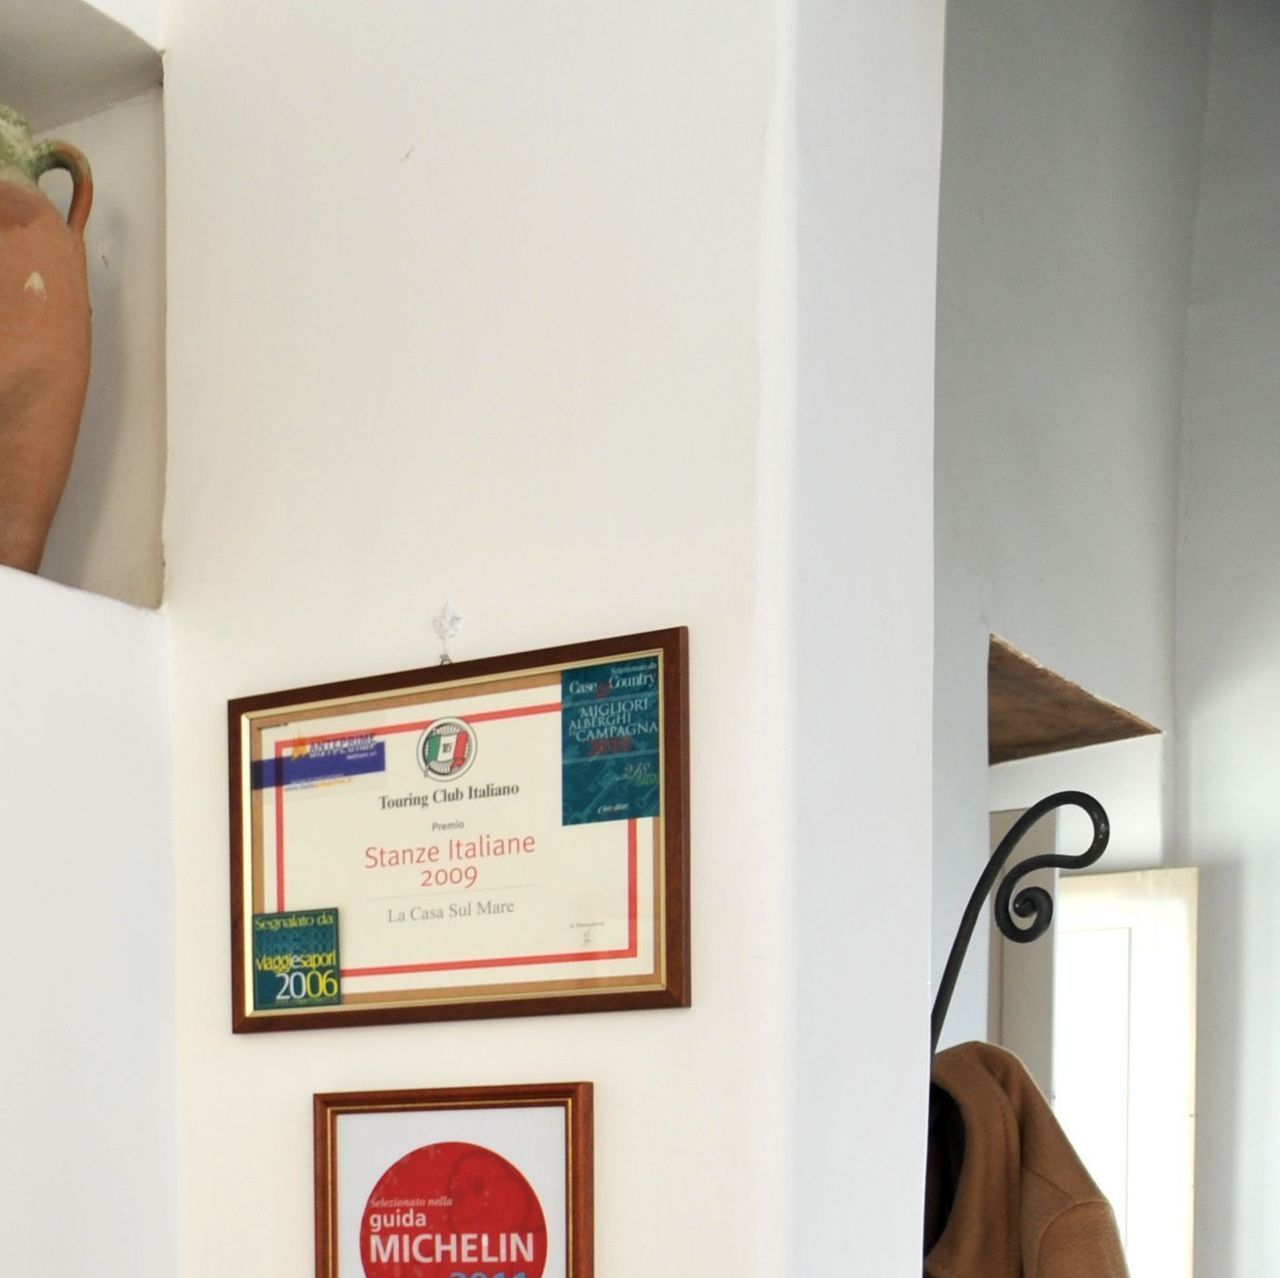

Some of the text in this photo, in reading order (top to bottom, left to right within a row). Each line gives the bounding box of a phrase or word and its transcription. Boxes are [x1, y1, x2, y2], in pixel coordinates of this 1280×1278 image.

[569, 681, 597, 694] Case
[608, 673, 656, 689] Country
[581, 698, 648, 718] MIGLIORI
[569, 713, 631, 731] ALBERGHI
[576, 721, 658, 742] CAMPAGNA
[378, 783, 520, 809] Touring Club Italiano
[432, 820, 464, 832] Premio
[364, 834, 536, 869] Stanze Italiane
[420, 866, 479, 889] 2009
[256, 912, 333, 931] Segnalato da
[388, 900, 514, 923] La Casa Sul Mare
[276, 969, 338, 1000] 2006
[369, 1196, 453, 1208] Selezionato nella
[369, 1208, 427, 1232] guida
[370, 1233, 534, 1263] MICHELIN
